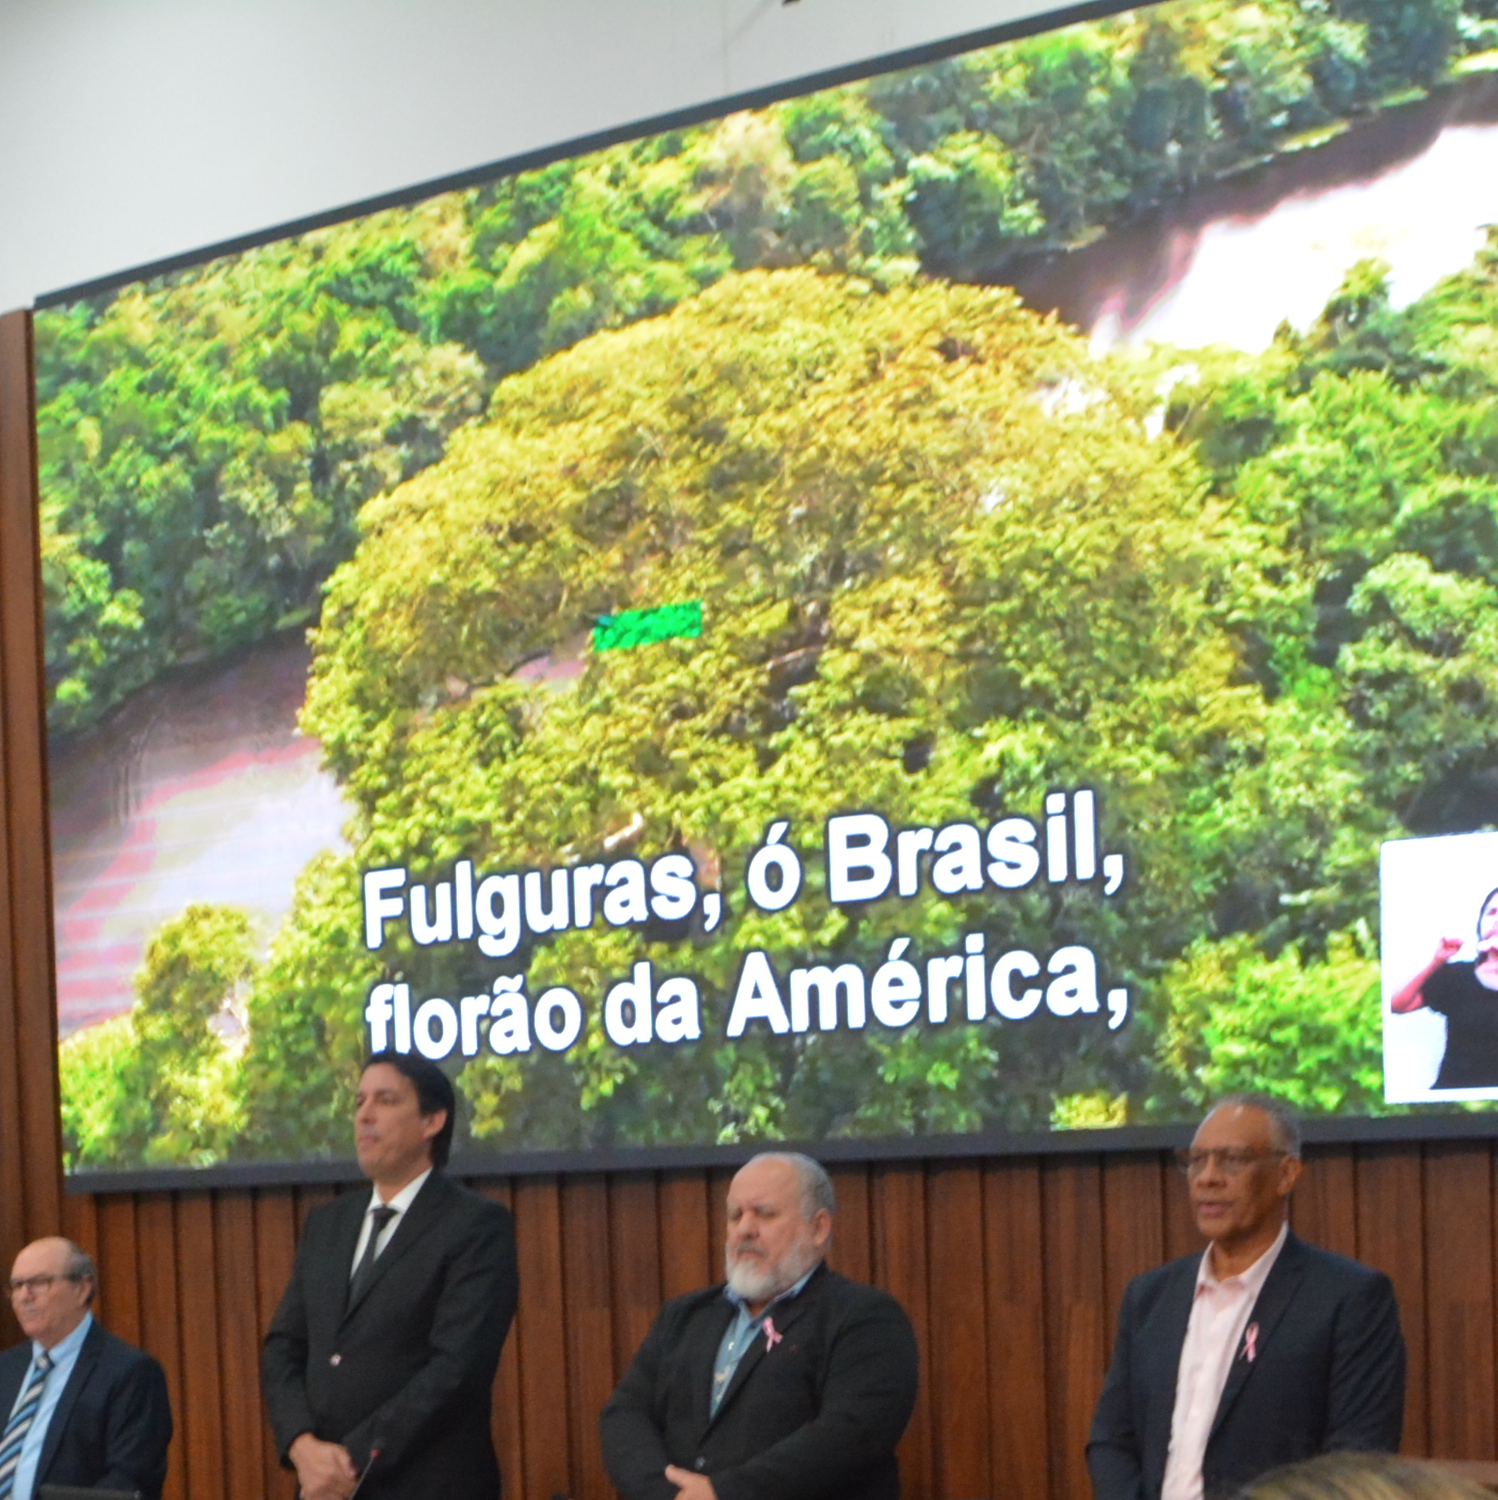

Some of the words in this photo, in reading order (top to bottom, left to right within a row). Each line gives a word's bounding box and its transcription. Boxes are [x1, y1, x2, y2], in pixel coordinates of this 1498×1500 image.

[364, 855, 721, 957] Fulguras,
[747, 822, 801, 910] ó
[828, 790, 1124, 903] Brasil,
[365, 974, 581, 1059] florão
[605, 962, 701, 1046] da
[726, 933, 1128, 1037] América,
